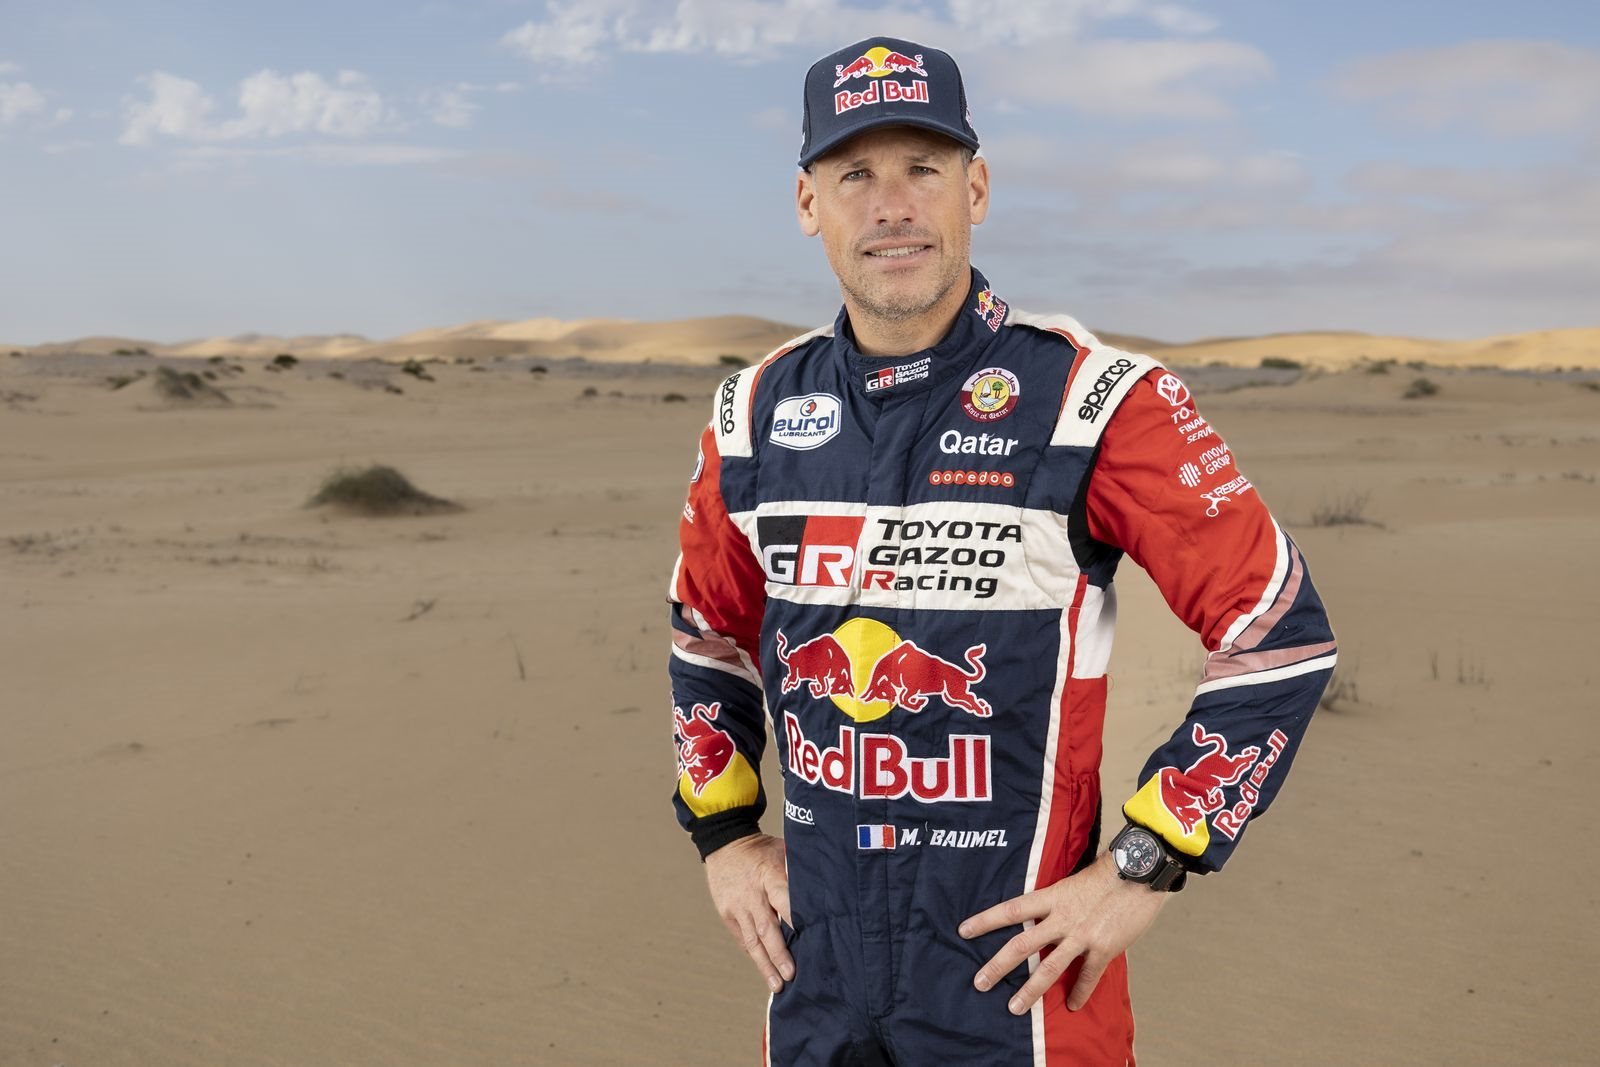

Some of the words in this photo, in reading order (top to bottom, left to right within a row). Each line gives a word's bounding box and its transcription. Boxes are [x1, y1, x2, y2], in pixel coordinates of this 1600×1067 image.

[835, 80, 880, 115] Red
[882, 79, 929, 103] Bull
[987, 309, 1004, 333] Red
[895, 357, 931, 372] TOYOTA
[895, 365, 929, 379] GAZOO
[866, 374, 893, 390] GR
[895, 371, 929, 385] Racing
[1078, 358, 1137, 424] sparco
[720, 373, 741, 436] sparco
[988, 407, 1009, 420] Qatar
[773, 410, 836, 432] eurol
[939, 429, 1019, 456] Qatar
[930, 471, 1013, 486] ooredoo
[877, 518, 1022, 542] TOYOTA
[762, 544, 855, 587] GR
[868, 545, 1005, 568] GAZOO
[862, 570, 998, 599] Racing
[784, 710, 855, 795] Red
[859, 732, 992, 804] Bull
[1212, 781, 1260, 841] Red
[1250, 728, 1288, 789] Bull
[901, 828, 922, 846] M.
[930, 829, 1009, 847] BAUMEL
